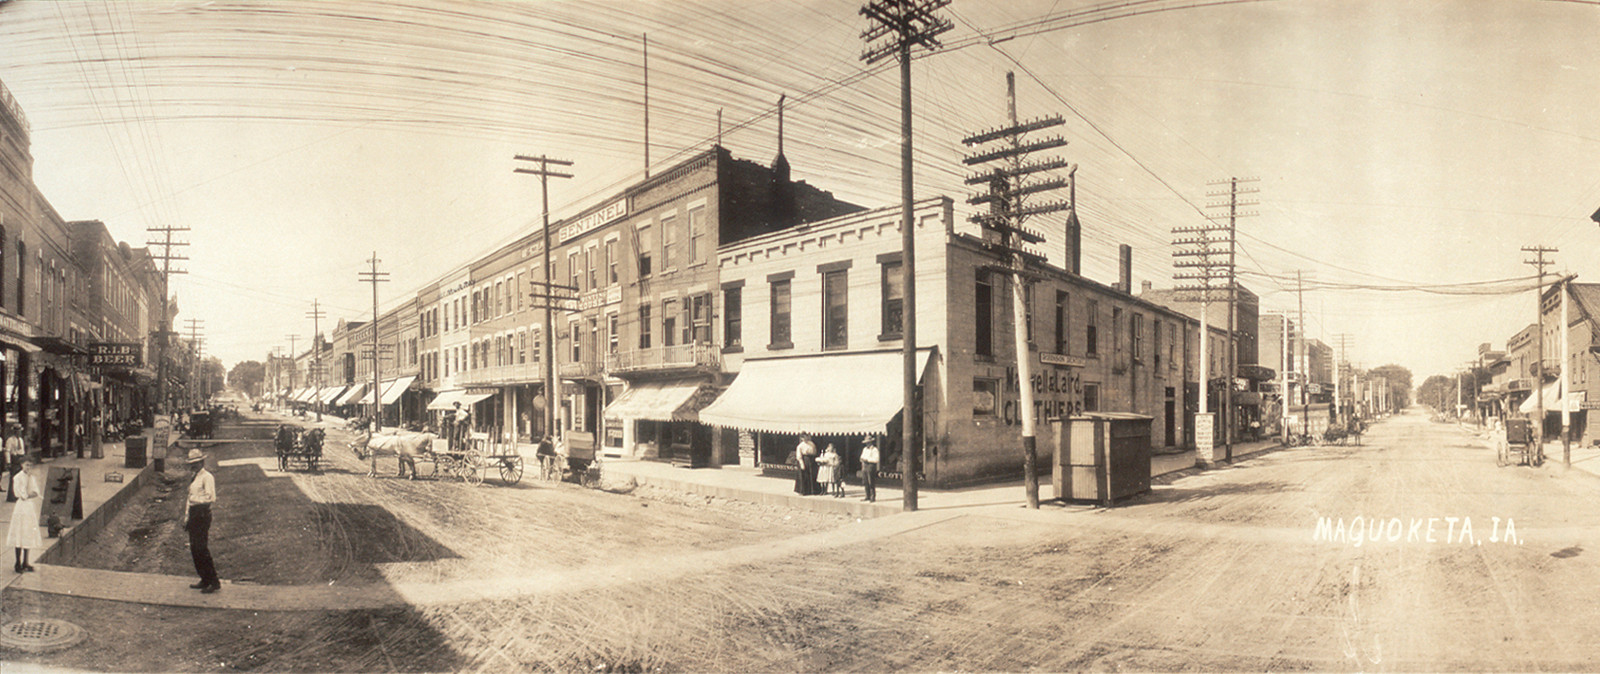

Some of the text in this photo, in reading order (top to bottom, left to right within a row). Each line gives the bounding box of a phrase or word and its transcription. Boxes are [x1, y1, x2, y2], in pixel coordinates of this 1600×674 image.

[560, 202, 625, 240] SENTINEL
[92, 354, 136, 365] BEER
[1004, 400, 1082, 426] CLTHIERS
